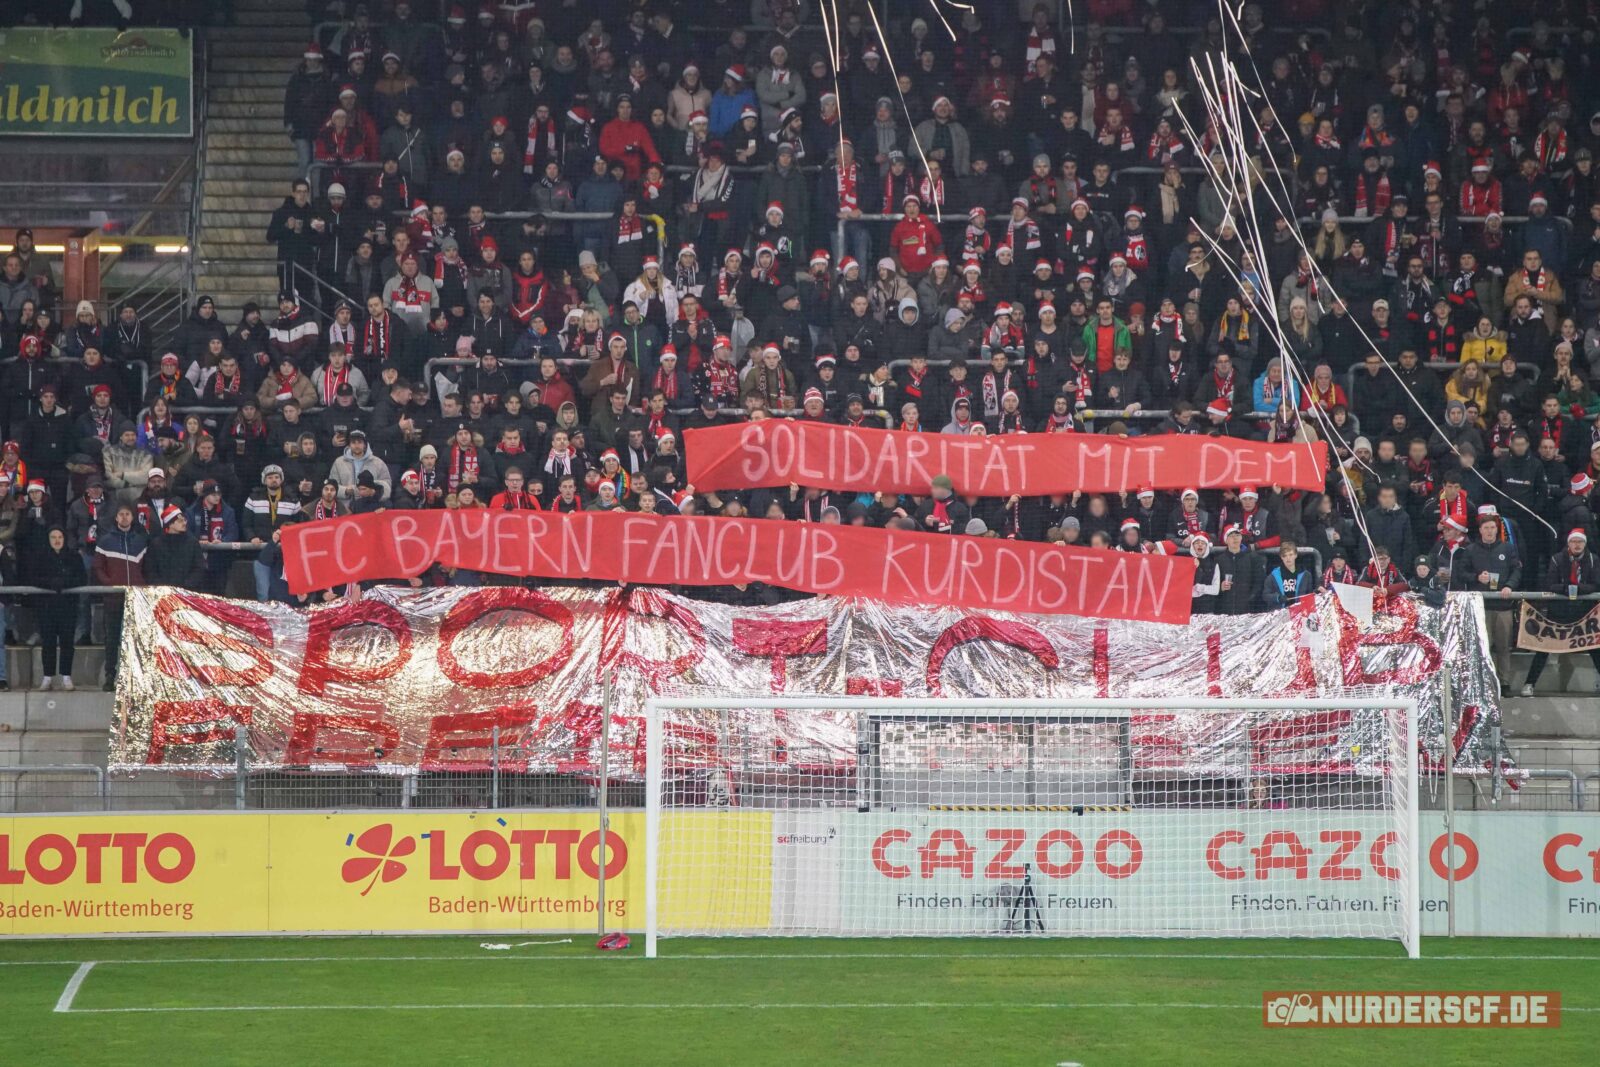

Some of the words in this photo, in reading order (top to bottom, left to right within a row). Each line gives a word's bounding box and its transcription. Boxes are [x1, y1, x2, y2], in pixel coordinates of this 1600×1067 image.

[0, 84, 180, 124] ldmilch
[740, 423, 1036, 491] SOLIDARITÄT
[1079, 440, 1165, 491] MIT
[1199, 442, 1298, 487] DEM
[299, 520, 368, 586] FC
[391, 511, 593, 575] BAYERN
[621, 517, 845, 590] FANCLUB
[881, 534, 1174, 617] KURDISTAN
[0, 832, 196, 885] LOTTO
[430, 829, 628, 881] LOTTO
[872, 829, 1144, 879] CAZOO
[1047, 894, 1118, 909] Freuen.
